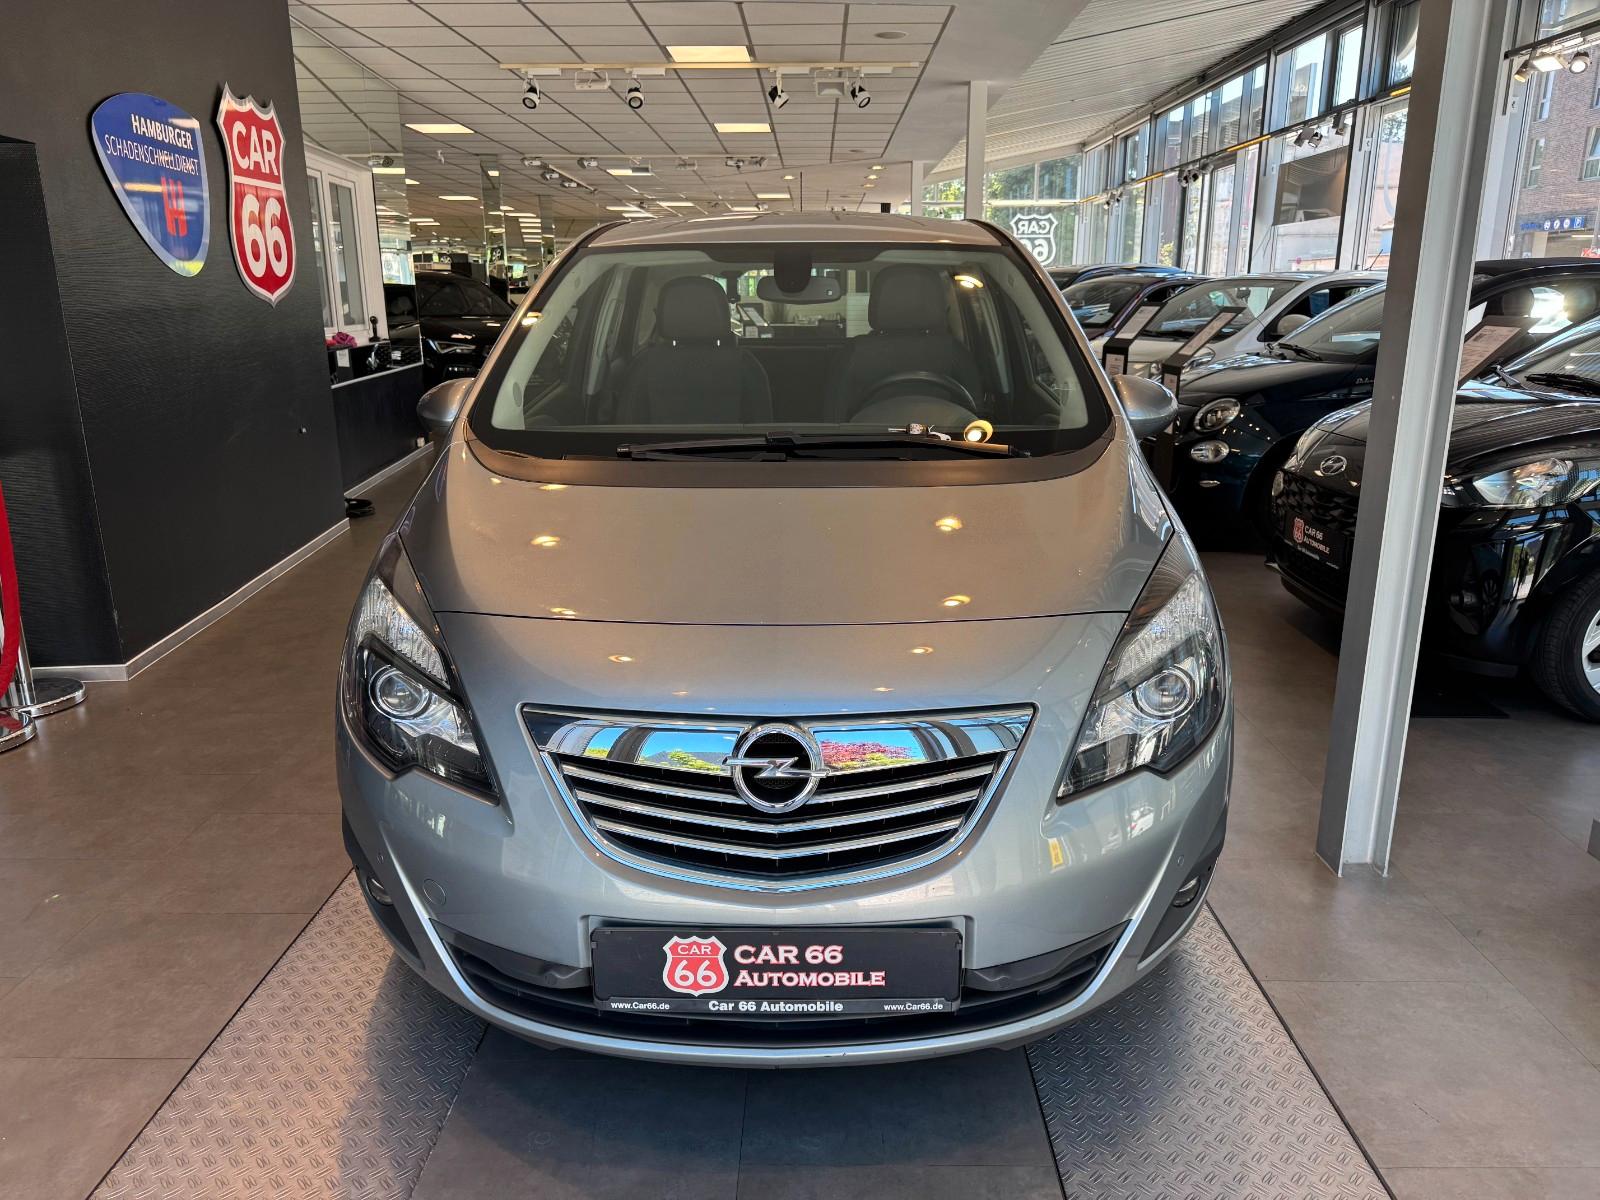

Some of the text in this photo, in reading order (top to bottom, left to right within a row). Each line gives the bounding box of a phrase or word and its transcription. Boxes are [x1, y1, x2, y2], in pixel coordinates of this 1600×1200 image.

[131, 113, 194, 151] HAMBURGER
[104, 134, 199, 176] SCHADENSCHNELLDIENST
[232, 120, 279, 176] CAR
[241, 193, 288, 278] 66
[1305, 525, 1316, 537] CAR
[677, 944, 713, 955] CAR
[733, 944, 844, 965] CAR 66
[674, 959, 718, 987] 66
[733, 969, 886, 987] AUTOMOBILE
[610, 1002, 670, 1011] www.Car66.de
[708, 1001, 844, 1013] Car 66 Automobile
[883, 1002, 944, 1011] www.Car66.de
